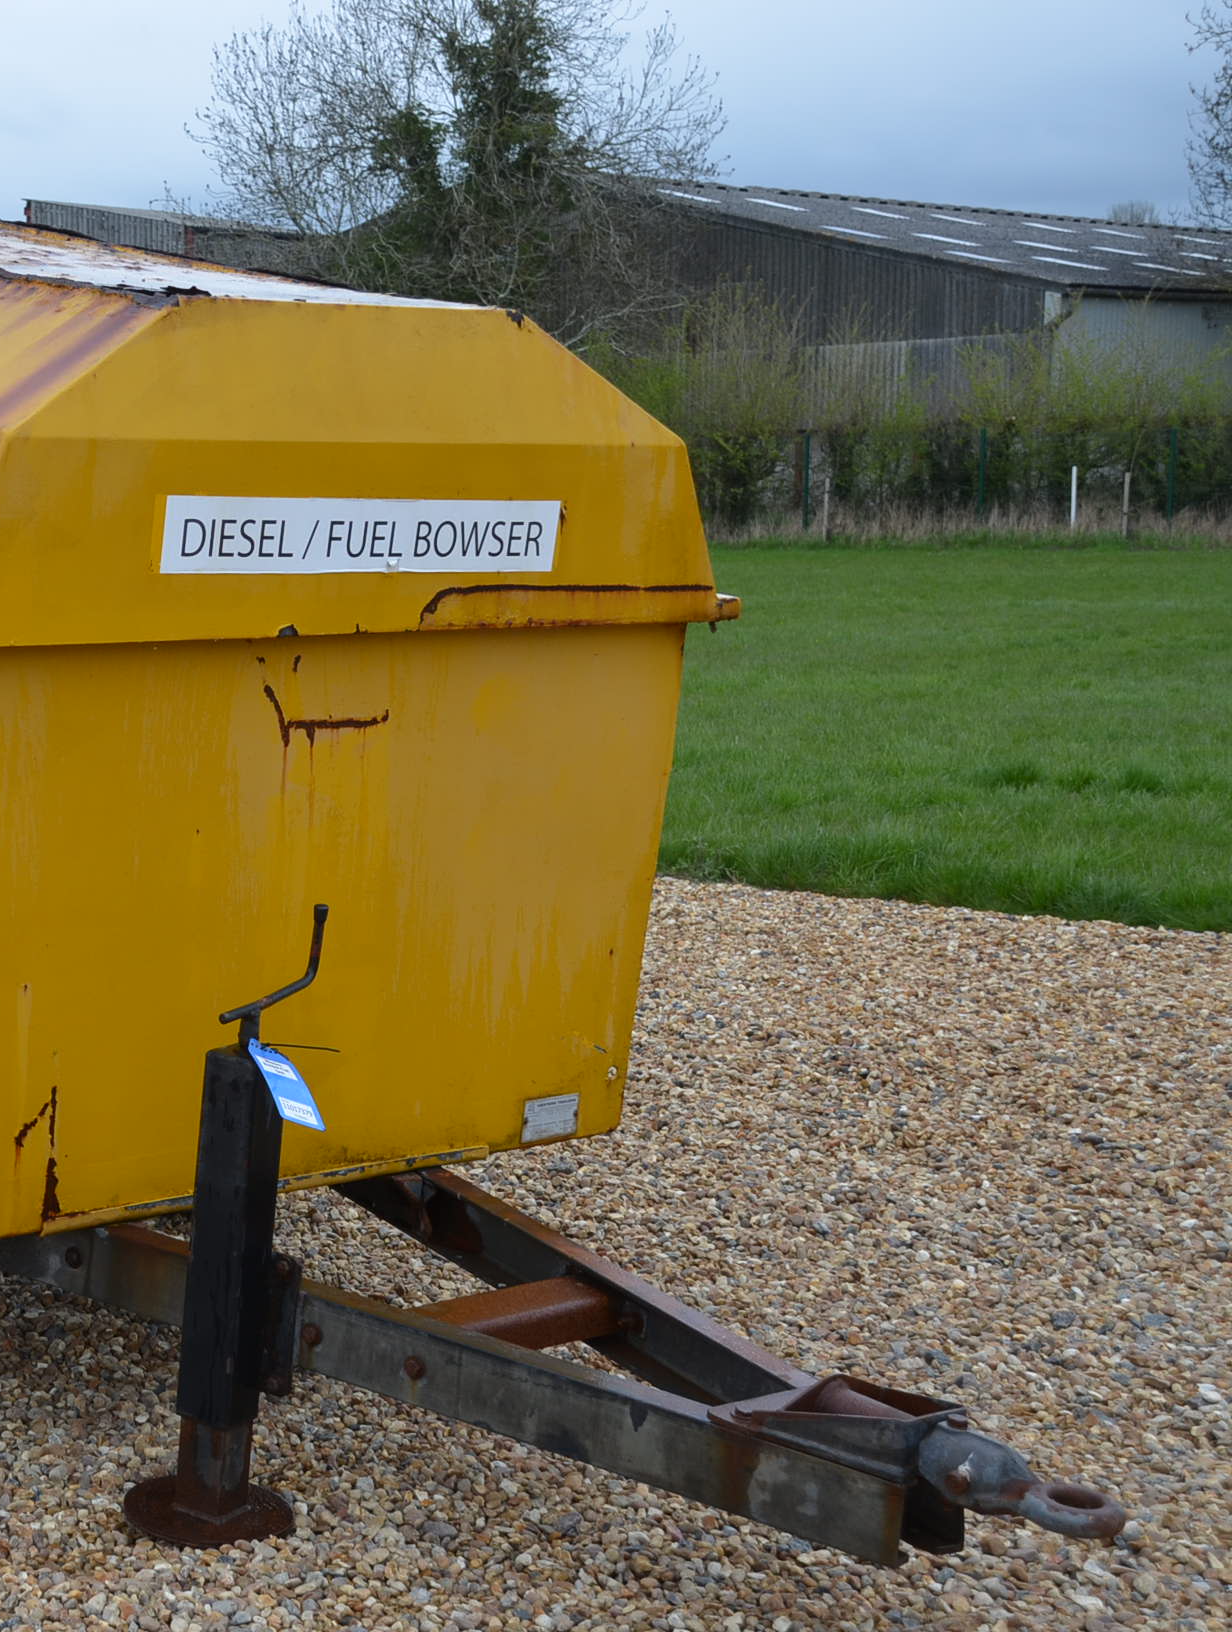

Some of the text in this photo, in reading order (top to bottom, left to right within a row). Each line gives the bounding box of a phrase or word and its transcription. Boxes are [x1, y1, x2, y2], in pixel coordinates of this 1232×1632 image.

[180, 518, 543, 559] DIESEL / FUEL BOWSER
